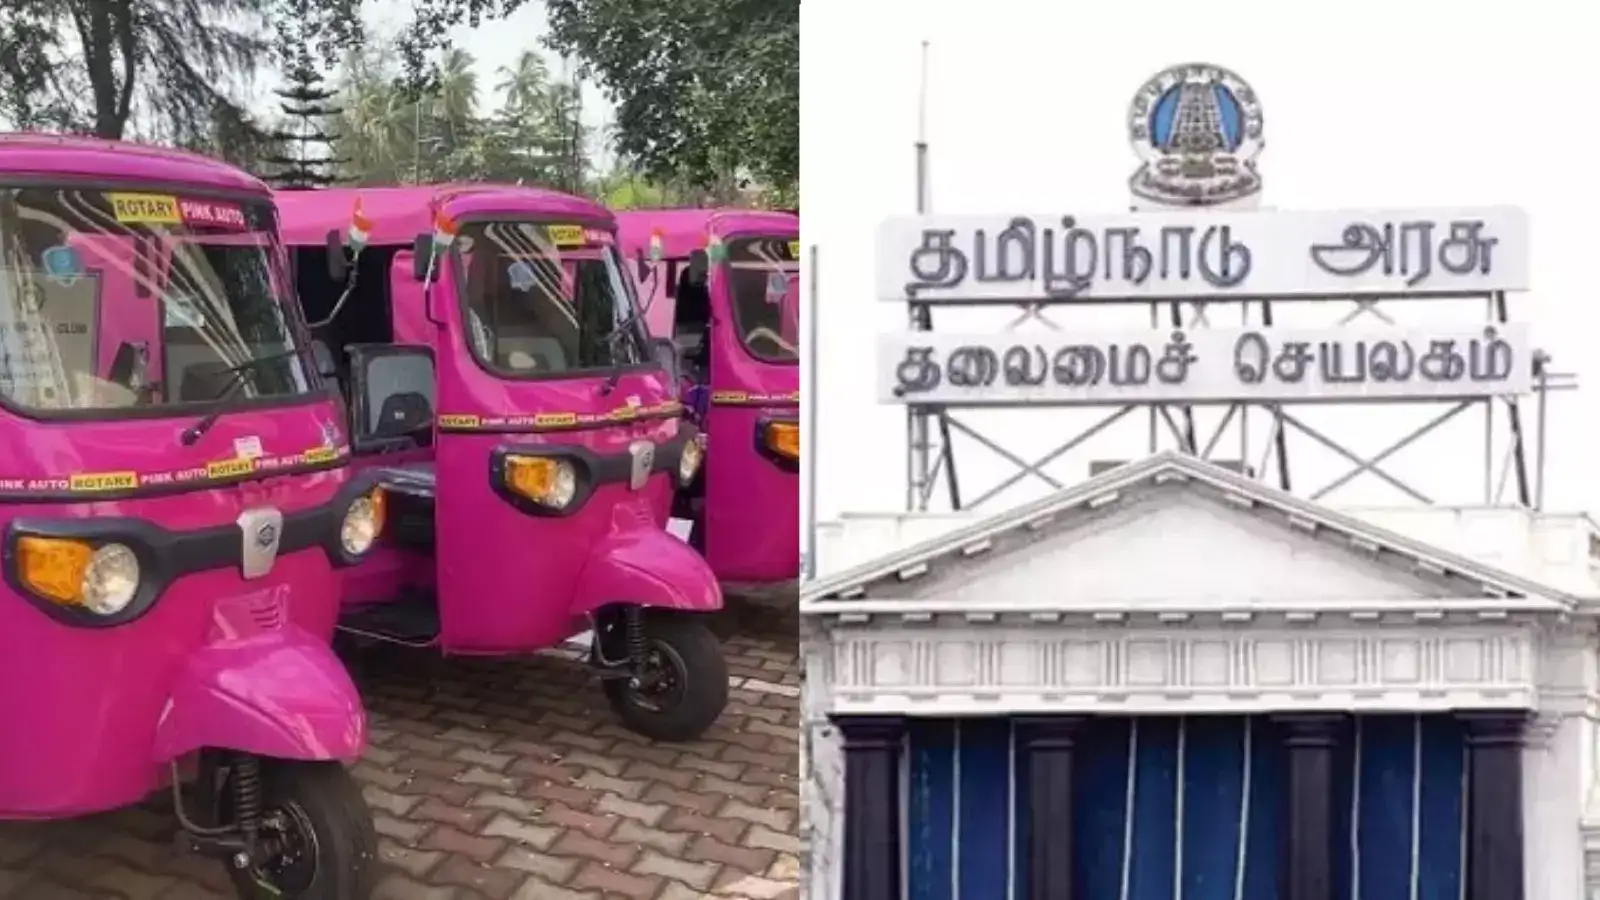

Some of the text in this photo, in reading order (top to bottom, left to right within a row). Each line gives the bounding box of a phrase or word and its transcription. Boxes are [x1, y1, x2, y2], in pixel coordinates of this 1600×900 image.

[115, 198, 244, 225] ROTARY PINK AUTO
[905, 215, 1498, 298] தமிழ்நாடு அரசு
[893, 326, 1512, 397] தலைமைச் செயலகம்
[28, 479, 69, 491] AUTO
[73, 475, 133, 489] ROTARY
[140, 471, 173, 484] PINK
[175, 467, 207, 481] AUTO
[209, 461, 250, 476] ROTARY
